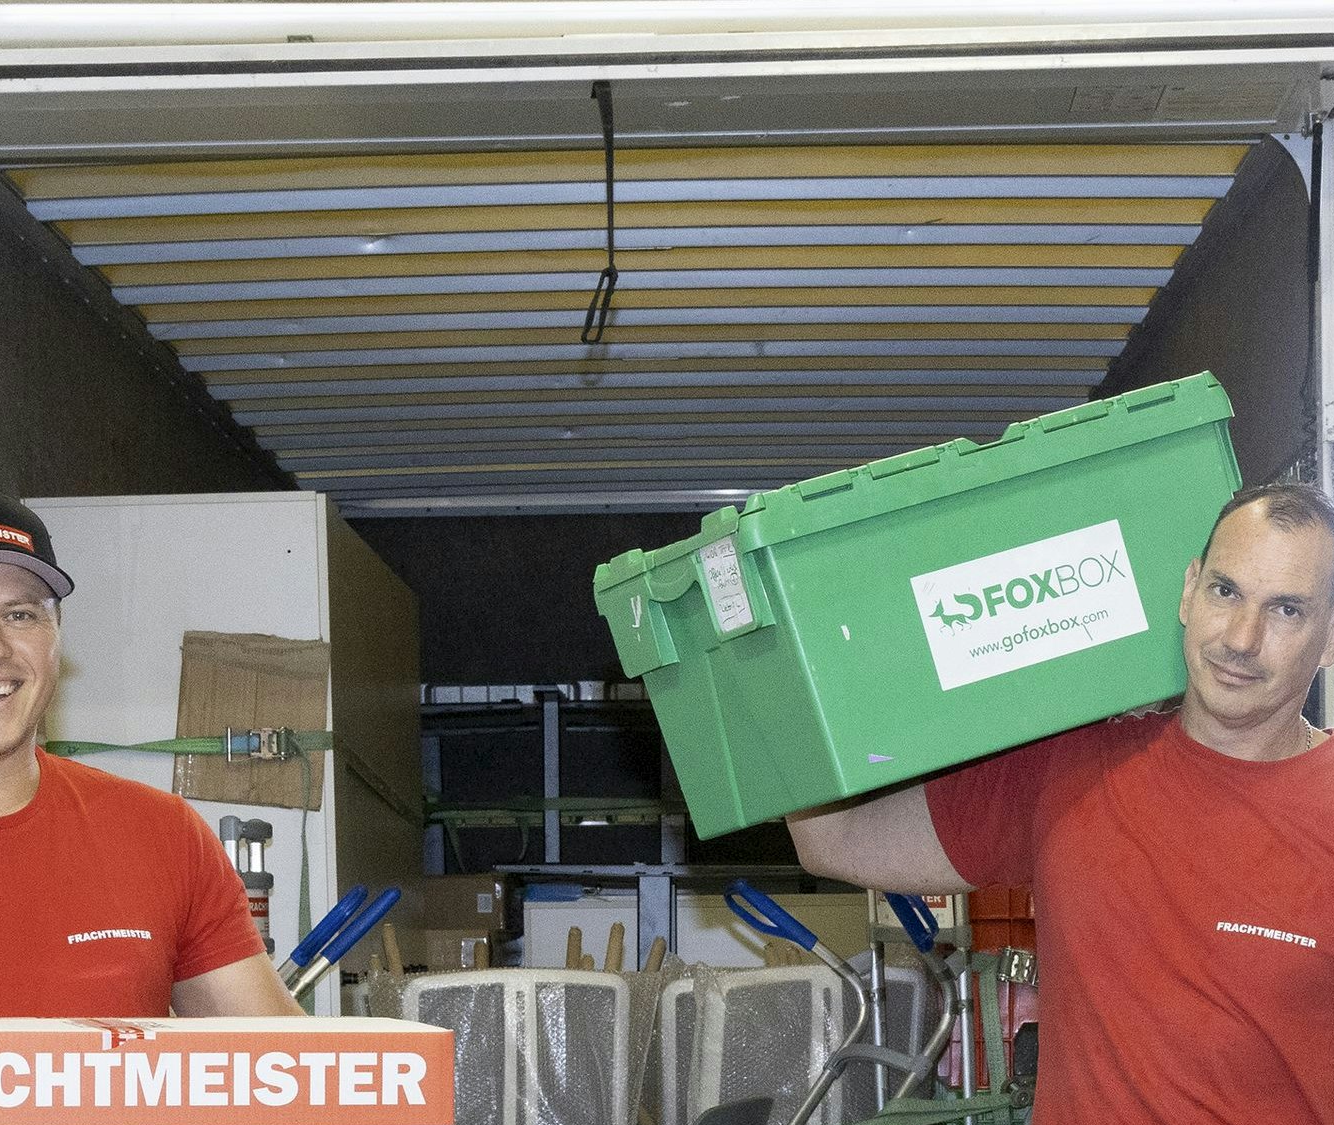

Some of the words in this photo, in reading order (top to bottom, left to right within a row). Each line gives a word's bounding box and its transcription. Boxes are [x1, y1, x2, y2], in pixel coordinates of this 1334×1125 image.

[969, 608, 1109, 658] www.gofoxbox.com
[67, 929, 152, 945] FRACHTMEISTER
[1216, 921, 1317, 949] FRACHTMEISTER
